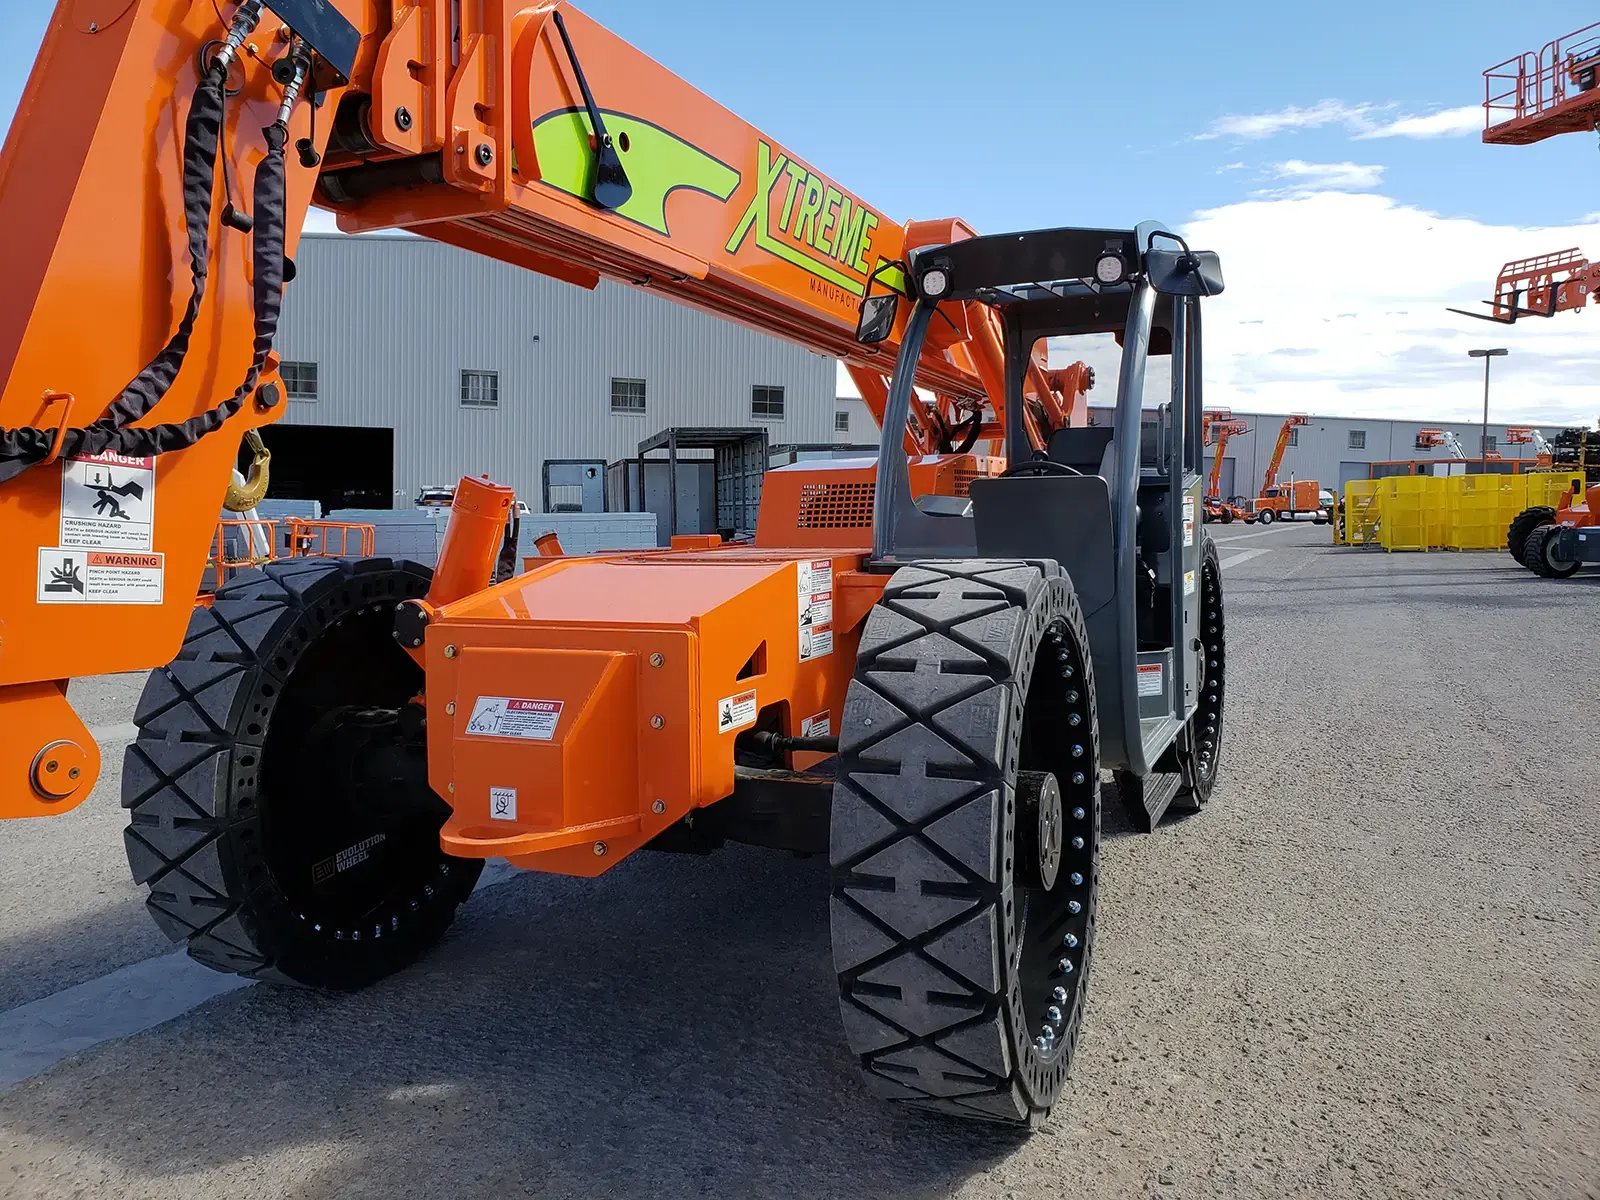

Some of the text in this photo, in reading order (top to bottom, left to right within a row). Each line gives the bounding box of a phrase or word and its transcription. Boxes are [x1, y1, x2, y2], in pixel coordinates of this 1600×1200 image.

[725, 138, 879, 276] XTREME
[105, 555, 157, 566] WARNING
[521, 702, 554, 710] DANGER
[335, 833, 386, 863] EVOLUTION
[336, 850, 370, 872] WHEEL
